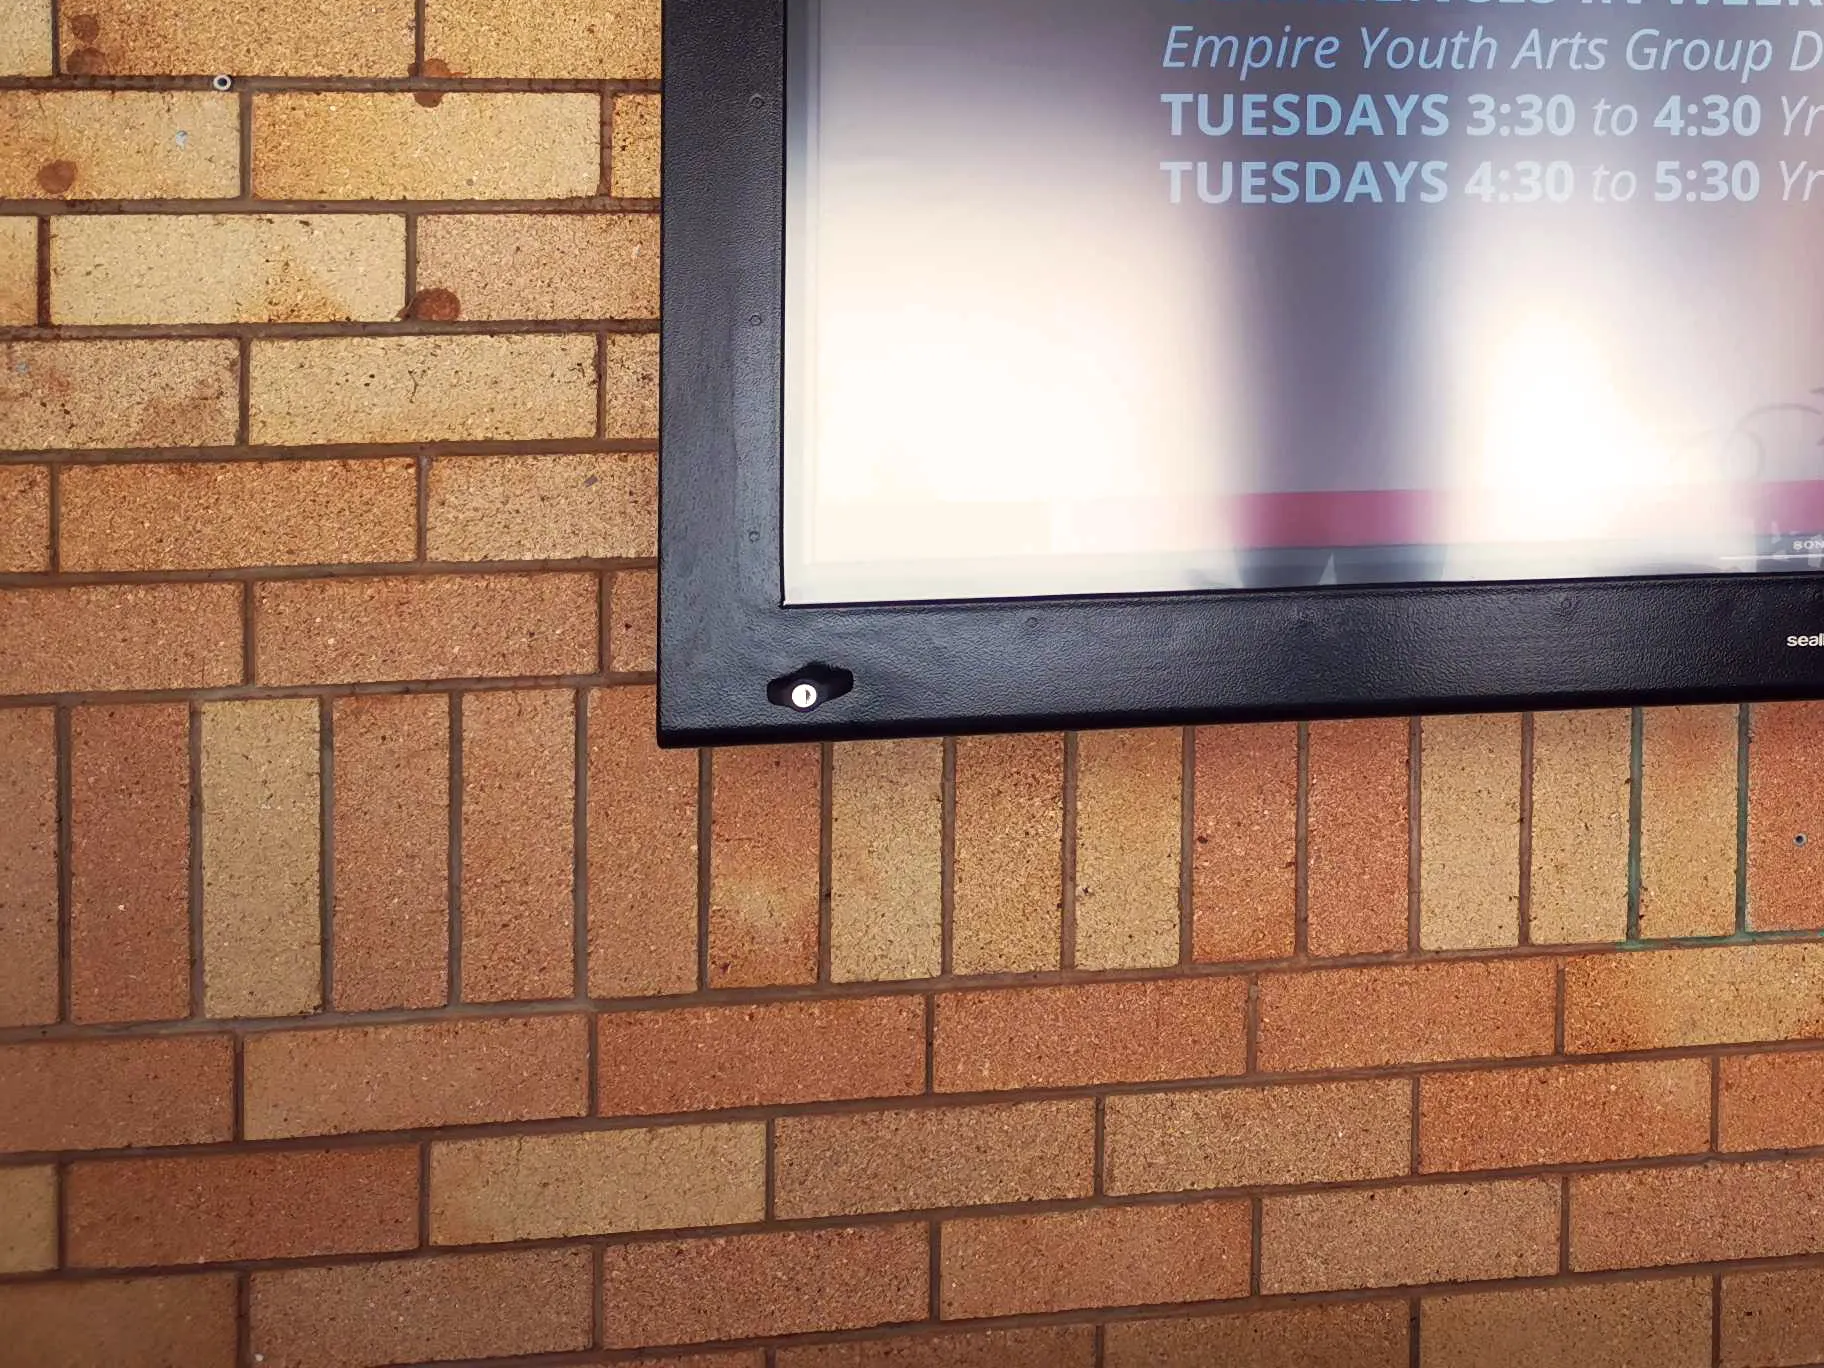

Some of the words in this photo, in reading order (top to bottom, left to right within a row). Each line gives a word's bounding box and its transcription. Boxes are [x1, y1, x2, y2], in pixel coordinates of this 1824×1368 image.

[1161, 26, 1342, 79] Empire
[1358, 27, 1500, 72] Youth
[1510, 29, 1609, 72] Arts
[1623, 29, 1774, 82] Group
[1160, 91, 1450, 136] TUESDAYS
[1464, 93, 1577, 136] 3:30
[1591, 96, 1639, 135] to
[1652, 94, 1762, 136] 4:30
[1160, 159, 1450, 203] TUESDAYS
[1463, 159, 1576, 202] 4:30
[1591, 162, 1638, 202] to
[1652, 159, 1762, 201] 5:30
